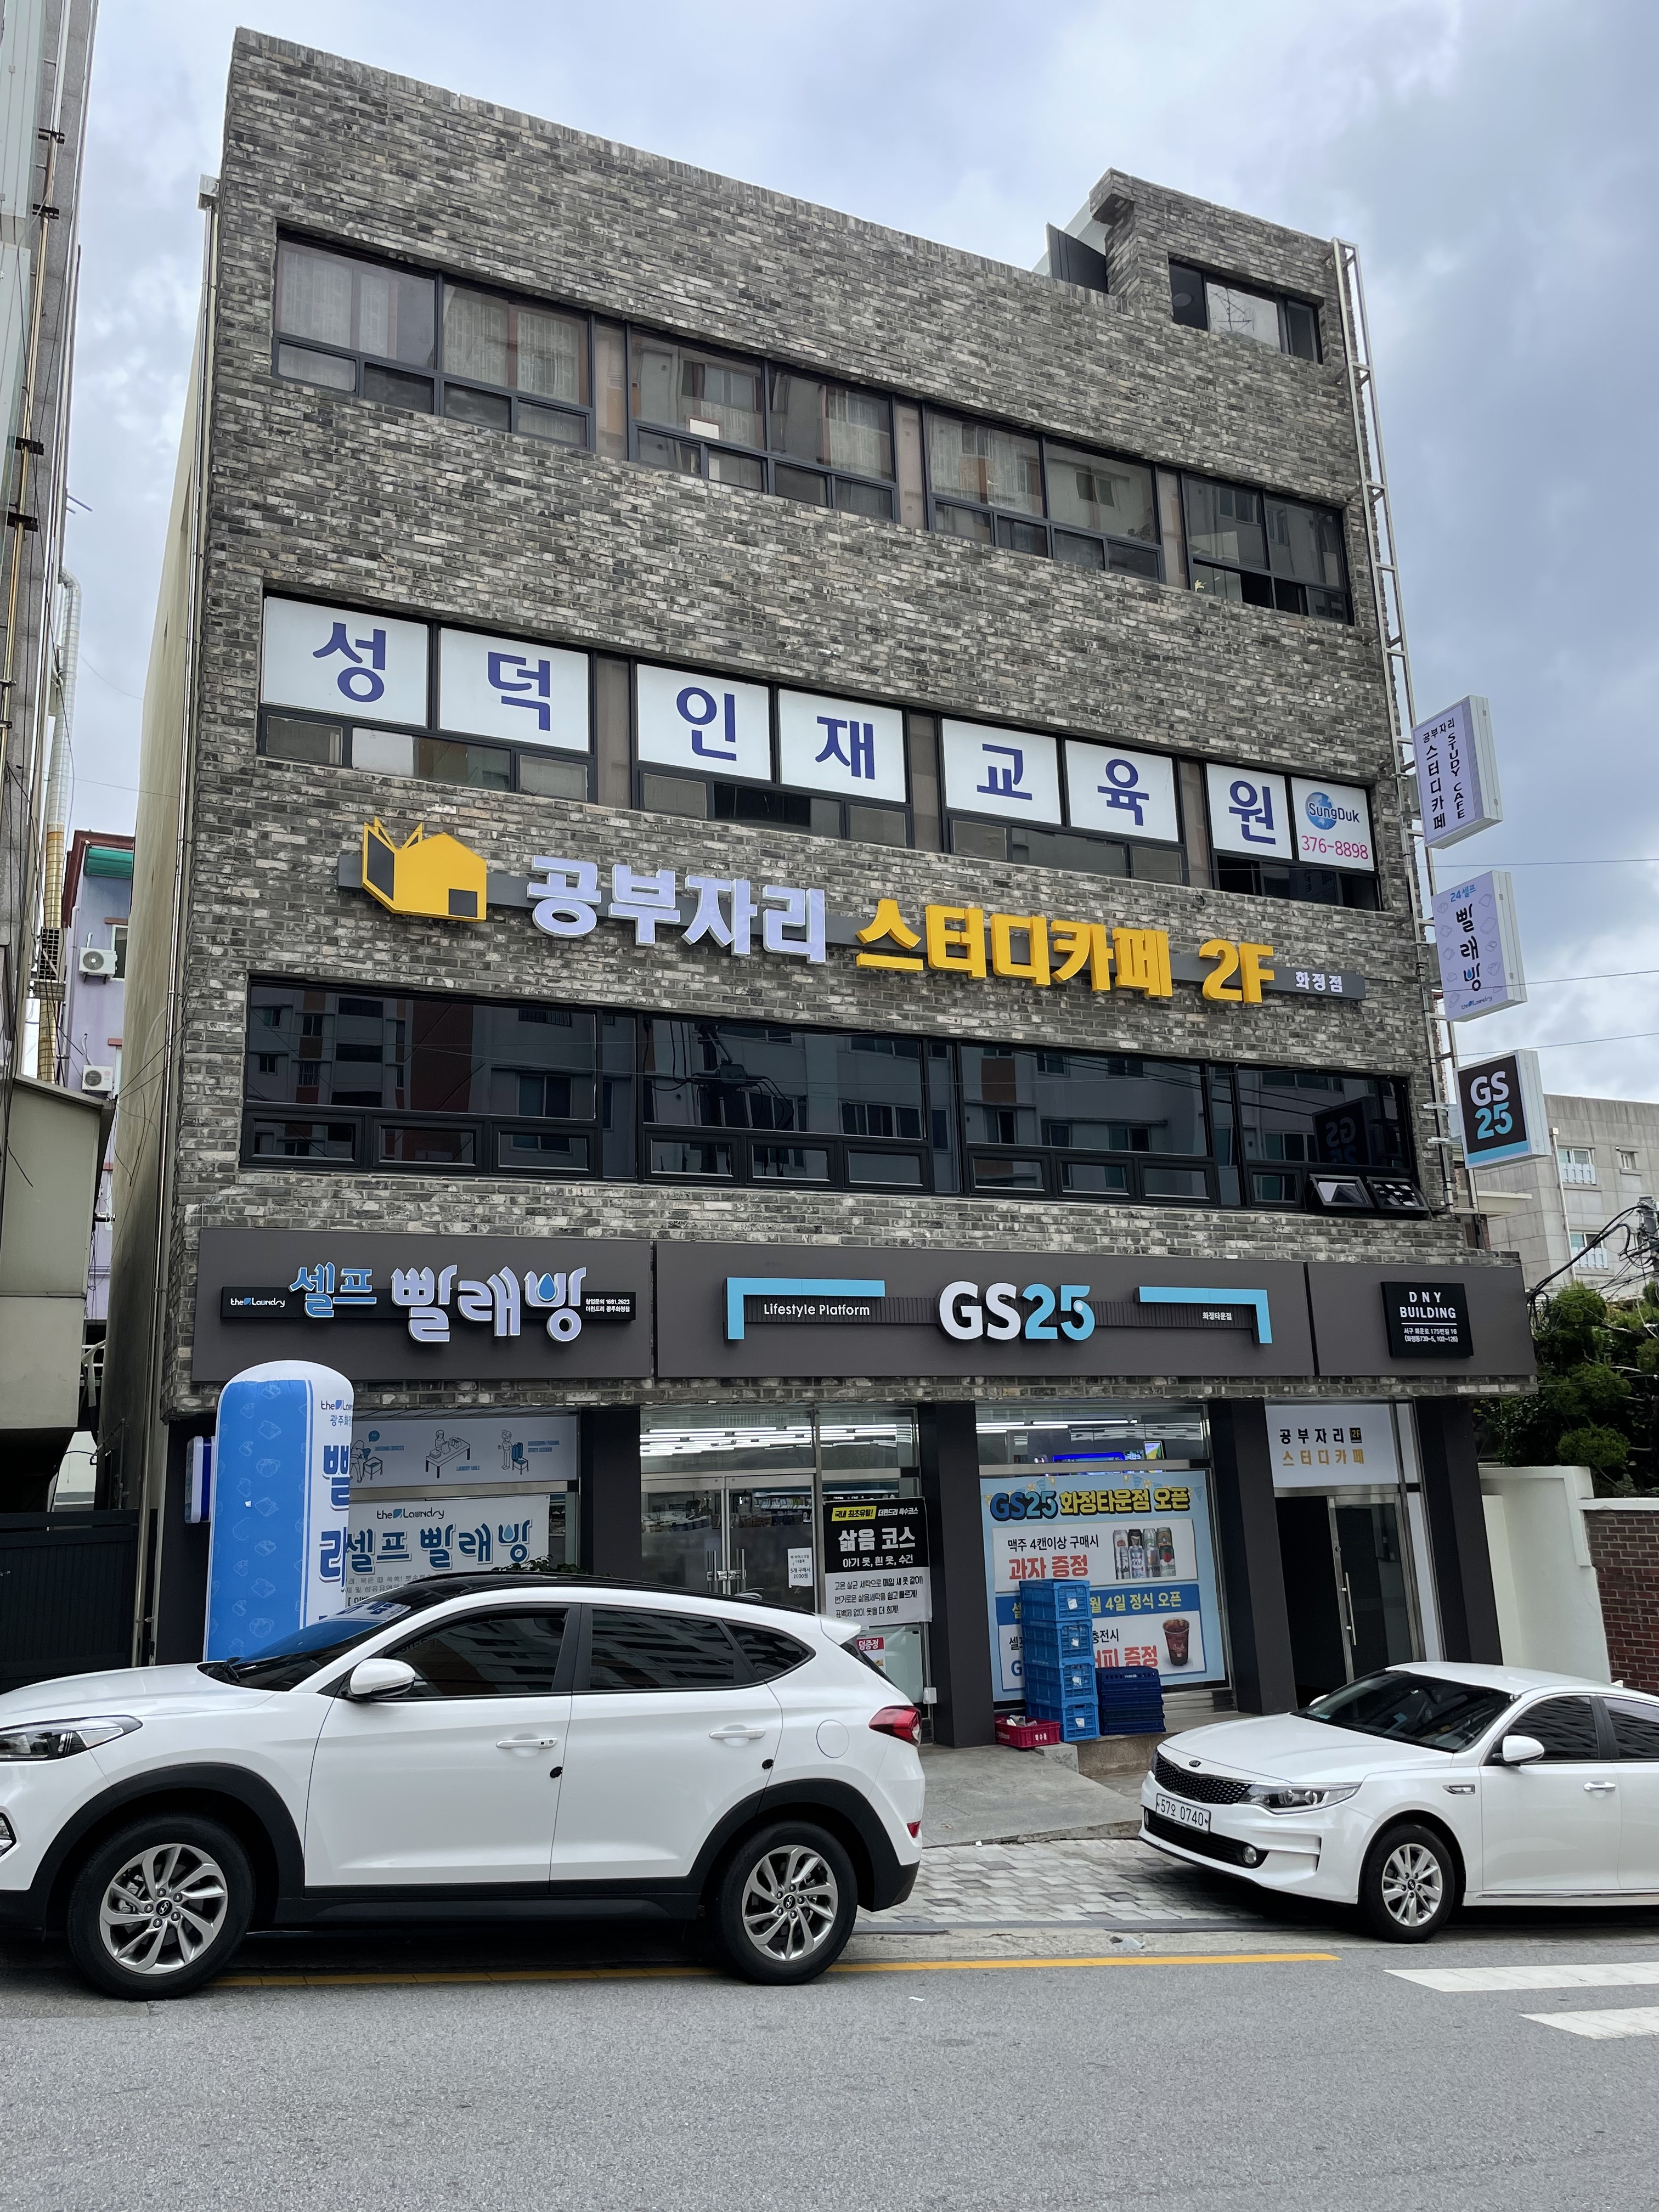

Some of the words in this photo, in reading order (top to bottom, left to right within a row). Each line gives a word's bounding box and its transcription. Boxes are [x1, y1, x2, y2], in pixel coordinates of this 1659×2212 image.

[1423, 718, 1455, 743] 공부자리
[1426, 745, 1446, 830] 스터디카페
[1448, 732, 1460, 777] STUDY
[1454, 782, 1465, 820] CAFE
[1308, 803, 1360, 823] SungDuk
[1301, 836, 1368, 860] 376-8898
[527, 855, 827, 965] 공부자리
[856, 898, 1173, 998] 스터디카페
[1199, 939, 1275, 1003] 2F
[1295, 971, 1343, 993] 화정점
[1456, 904, 1481, 991] 빨래방
[1470, 1071, 1509, 1107] GS
[1475, 1102, 1513, 1140] 25
[287, 1261, 377, 1318] 셀프
[390, 1264, 587, 1342] 빨래방
[764, 1303, 816, 1318] Lifestyle
[819, 1304, 870, 1316] Platform
[938, 1280, 1096, 1341] GS25
[1400, 1306, 1457, 1318] BUILDING
[1202, 1312, 1232, 1321] 화정타운점
[1283, 1448, 1365, 1466] 스터디카페
[377, 1510, 393, 1520] the
[403, 1507, 445, 1520] Laundry
[835, 1510, 847, 1519] 국내
[990, 1490, 1059, 1522] GS25
[1059, 1488, 1152, 1516] 화정타운점
[1153, 1487, 1191, 1512] 오픈
[347, 1528, 410, 1573] 셀프
[420, 1519, 531, 1571] 빨래방
[838, 1528, 876, 1552] 삶음
[882, 1526, 916, 1550] 코스
[1007, 1538, 1028, 1553] 맥주
[1030, 1536, 1068, 1550] 4캔이상
[1070, 1534, 1099, 1549] 구매시
[843, 1558, 860, 1568] 아기
[899, 1554, 913, 1564] 수건
[1008, 1556, 1047, 1580] 과자
[1052, 1554, 1089, 1578] 증정
[834, 1594, 856, 1604] 번거로운
[879, 1606, 885, 1615] 더
[1105, 1594, 1126, 1612] 4일
[1130, 1592, 1154, 1610] 정식
[1158, 1591, 1182, 1608] 오픈
[1160, 1798, 1176, 1817] 57오
[1180, 1805, 1204, 1827] 0740
